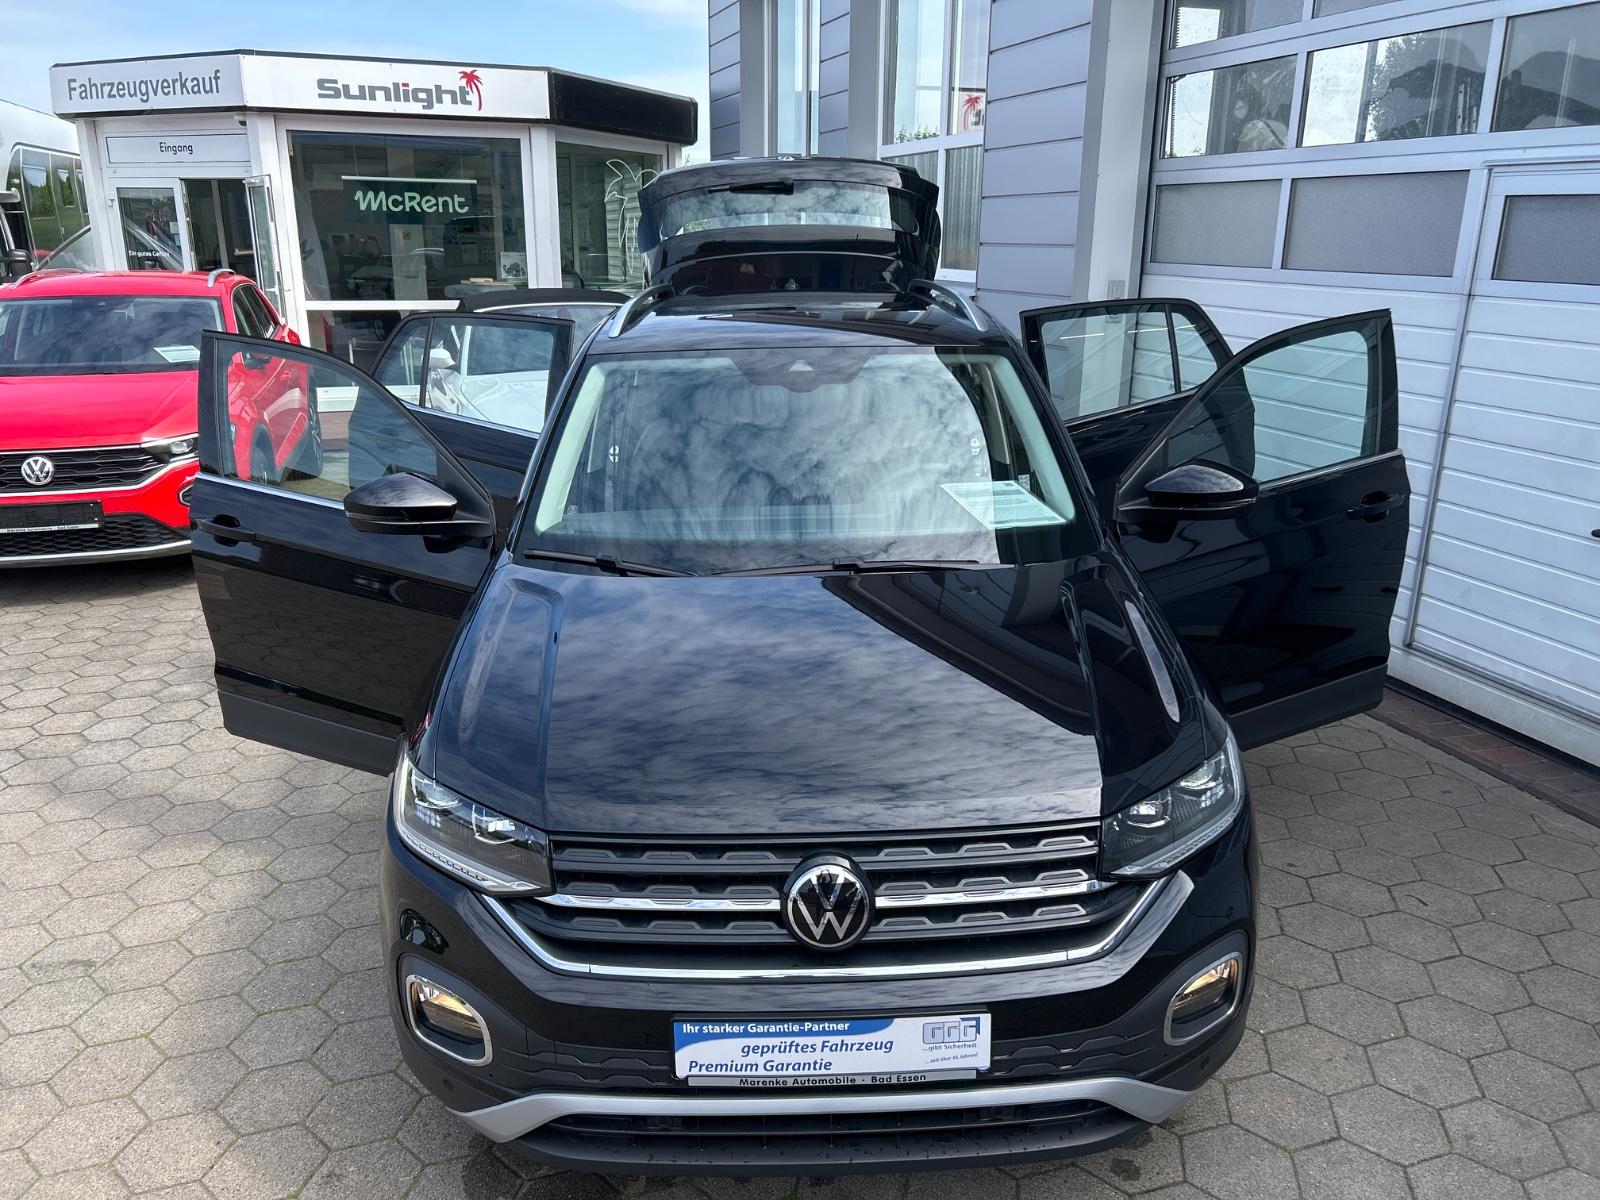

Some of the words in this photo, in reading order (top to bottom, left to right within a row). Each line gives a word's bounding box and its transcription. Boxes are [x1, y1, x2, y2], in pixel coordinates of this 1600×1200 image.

[67, 69, 221, 103] Fahrzeugverkauf
[316, 78, 473, 110] Sunlight
[159, 142, 193, 155] Eingang
[354, 190, 469, 214] McRent
[683, 1023, 700, 1034] Ihr
[702, 1023, 745, 1034] starker
[747, 1022, 850, 1033] Garantie-Partner
[741, 1040, 817, 1058] geprüftes
[820, 1038, 894, 1053] Fahrzeug
[944, 1042, 977, 1050] Sicherheit
[688, 1059, 759, 1073] Premium
[763, 1058, 833, 1072] Garantie
[739, 1078, 788, 1087] Marenke
[792, 1076, 857, 1086] Automobile
[871, 1075, 892, 1084] Bad
[897, 1074, 926, 1083] Essen
